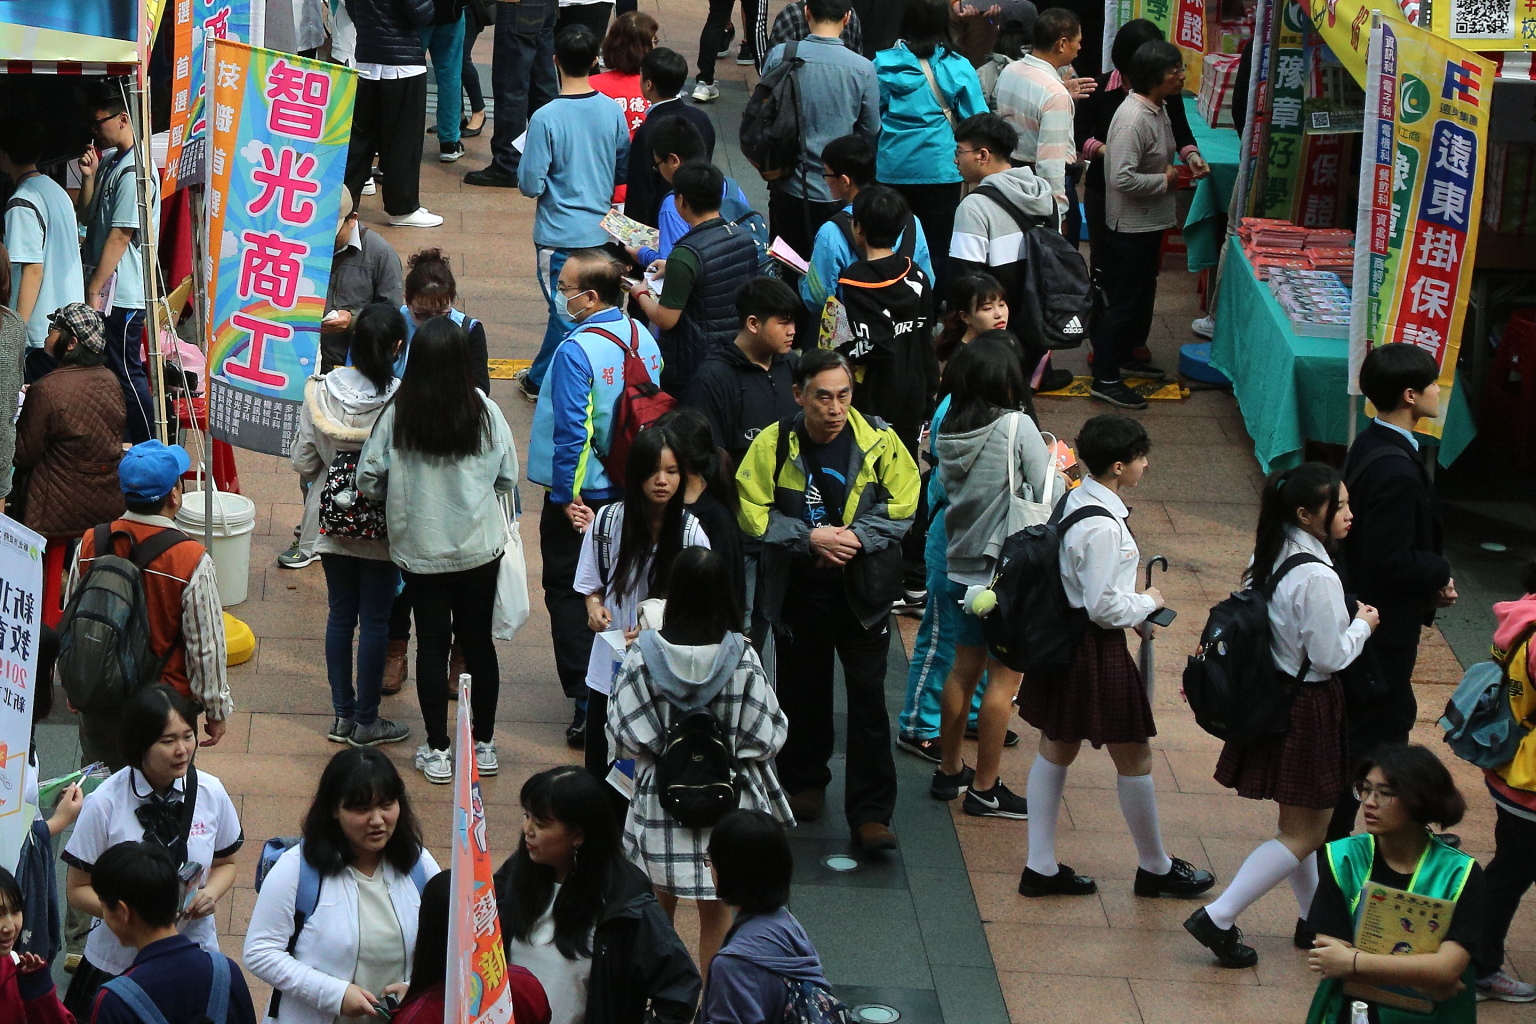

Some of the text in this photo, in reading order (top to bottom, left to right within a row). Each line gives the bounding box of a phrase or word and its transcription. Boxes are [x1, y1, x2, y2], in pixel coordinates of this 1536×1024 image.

[1384, 35, 1395, 73] 資訊科
[1382, 78, 1395, 118] 電子科
[1439, 101, 1478, 127] 遠東集團
[166, 57, 190, 182] 首選智光
[1264, 53, 1304, 212] 豫章好學
[1380, 123, 1392, 162] 電機科
[1377, 168, 1390, 207] 餐飲科
[224, 58, 330, 388] 智光商工
[1375, 213, 1387, 252] 資處科
[1402, 127, 1471, 356] 遠東掛保證
[1063, 326, 1084, 334] adidas
[272, 402, 283, 429] 美工科
